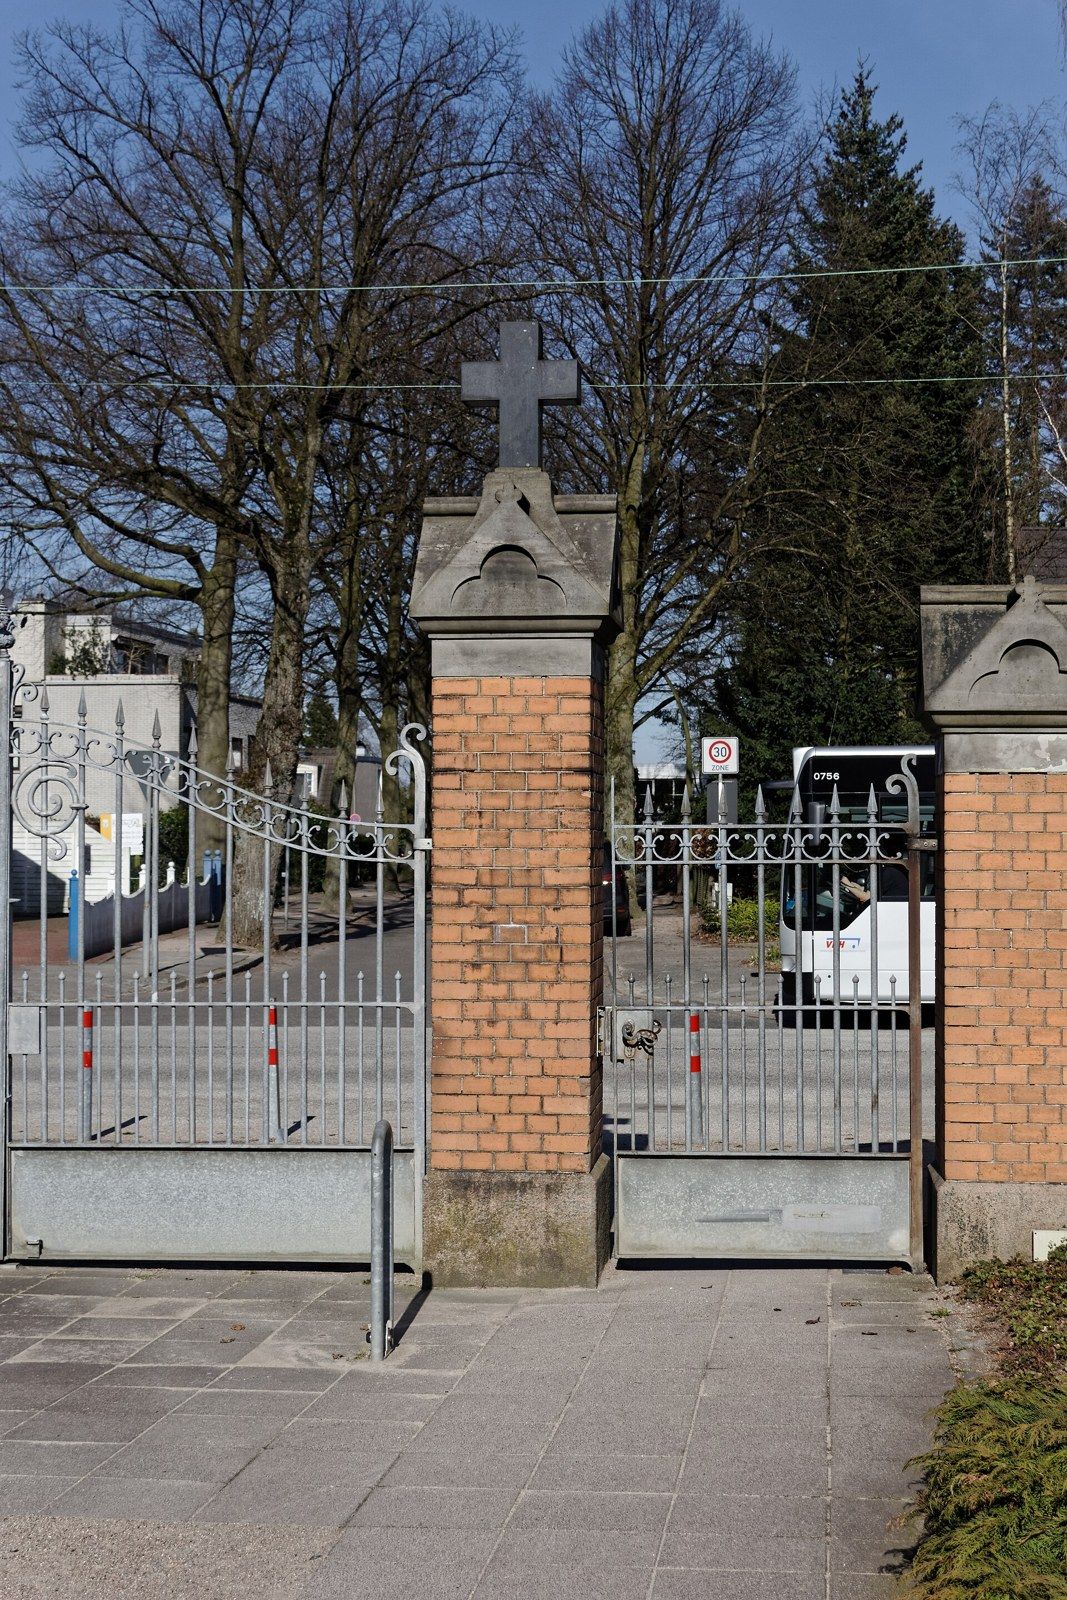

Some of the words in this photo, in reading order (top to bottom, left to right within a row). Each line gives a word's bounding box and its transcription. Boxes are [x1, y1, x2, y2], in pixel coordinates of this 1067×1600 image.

[713, 747, 727, 758] 30
[813, 772, 840, 781] 0756
[826, 941, 845, 949] VH
